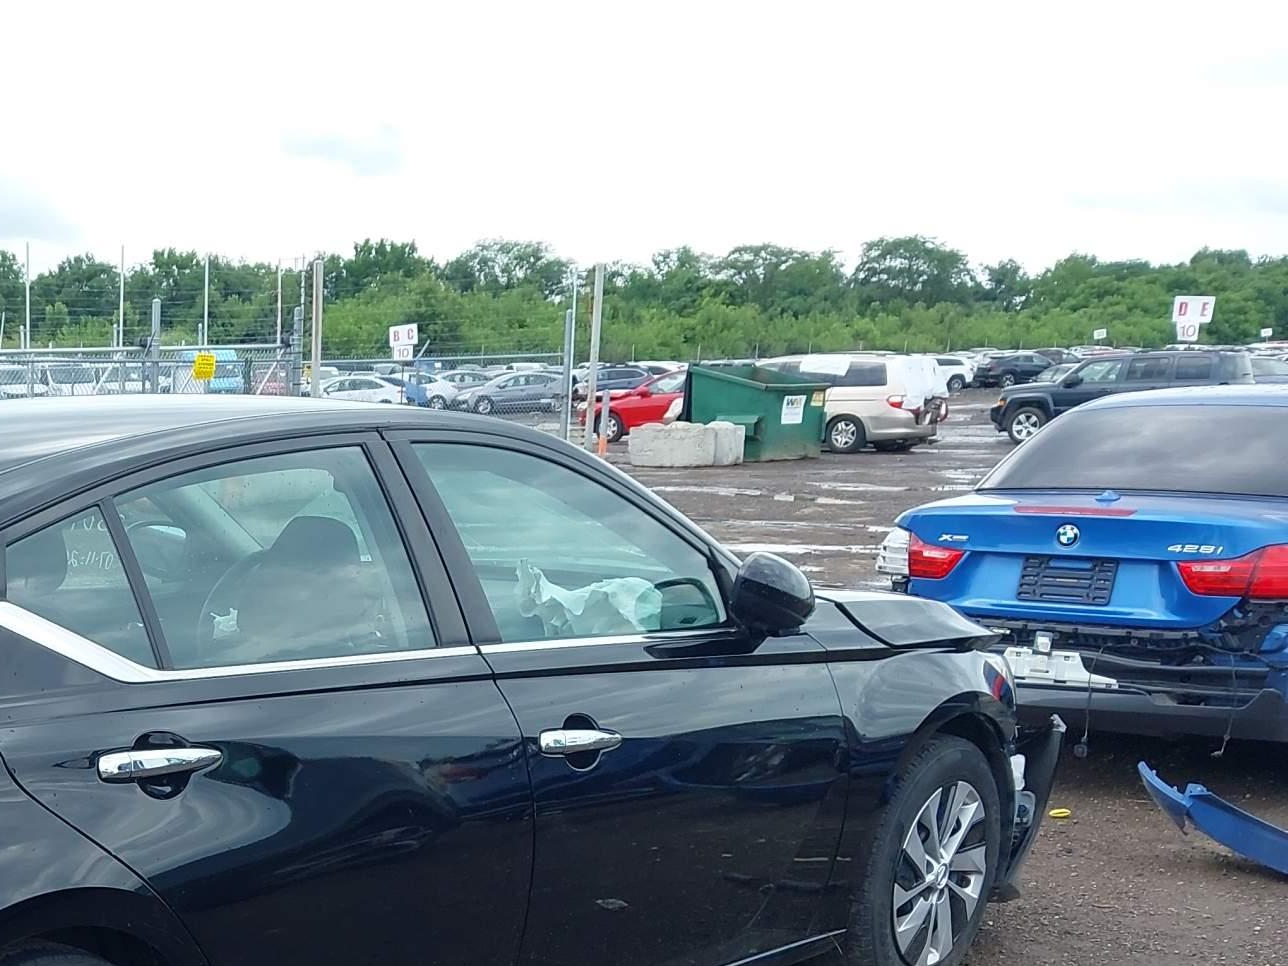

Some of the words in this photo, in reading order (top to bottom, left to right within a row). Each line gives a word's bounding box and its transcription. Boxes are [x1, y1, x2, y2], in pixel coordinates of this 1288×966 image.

[1178, 301, 1188, 317] D
[1200, 302, 1209, 317] E
[393, 330, 400, 342] B
[407, 328, 414, 340] C
[1179, 324, 1196, 337] 10
[397, 348, 410, 358] 10
